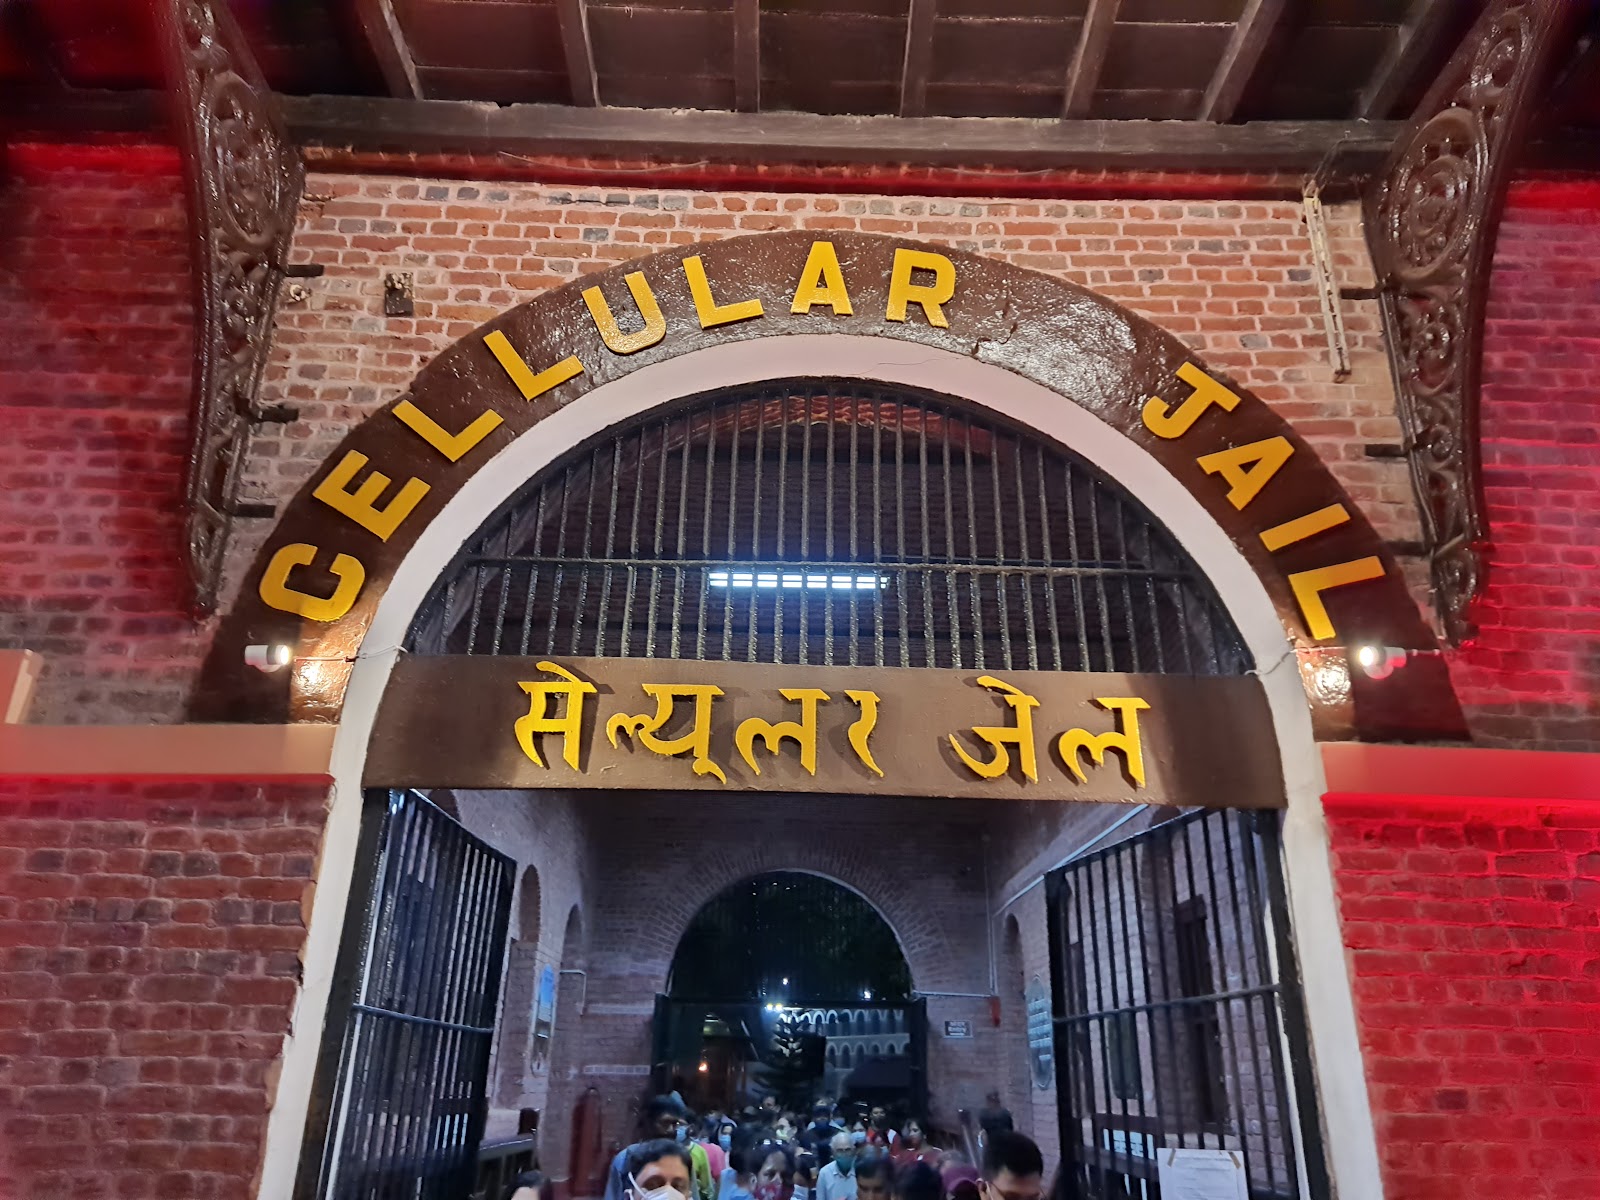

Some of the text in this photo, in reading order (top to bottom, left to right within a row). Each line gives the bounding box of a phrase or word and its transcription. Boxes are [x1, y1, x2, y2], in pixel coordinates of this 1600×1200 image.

[259, 241, 1386, 641] CELLULAR JAIL
[514, 660, 1152, 789] सेल्यूलर जेल
